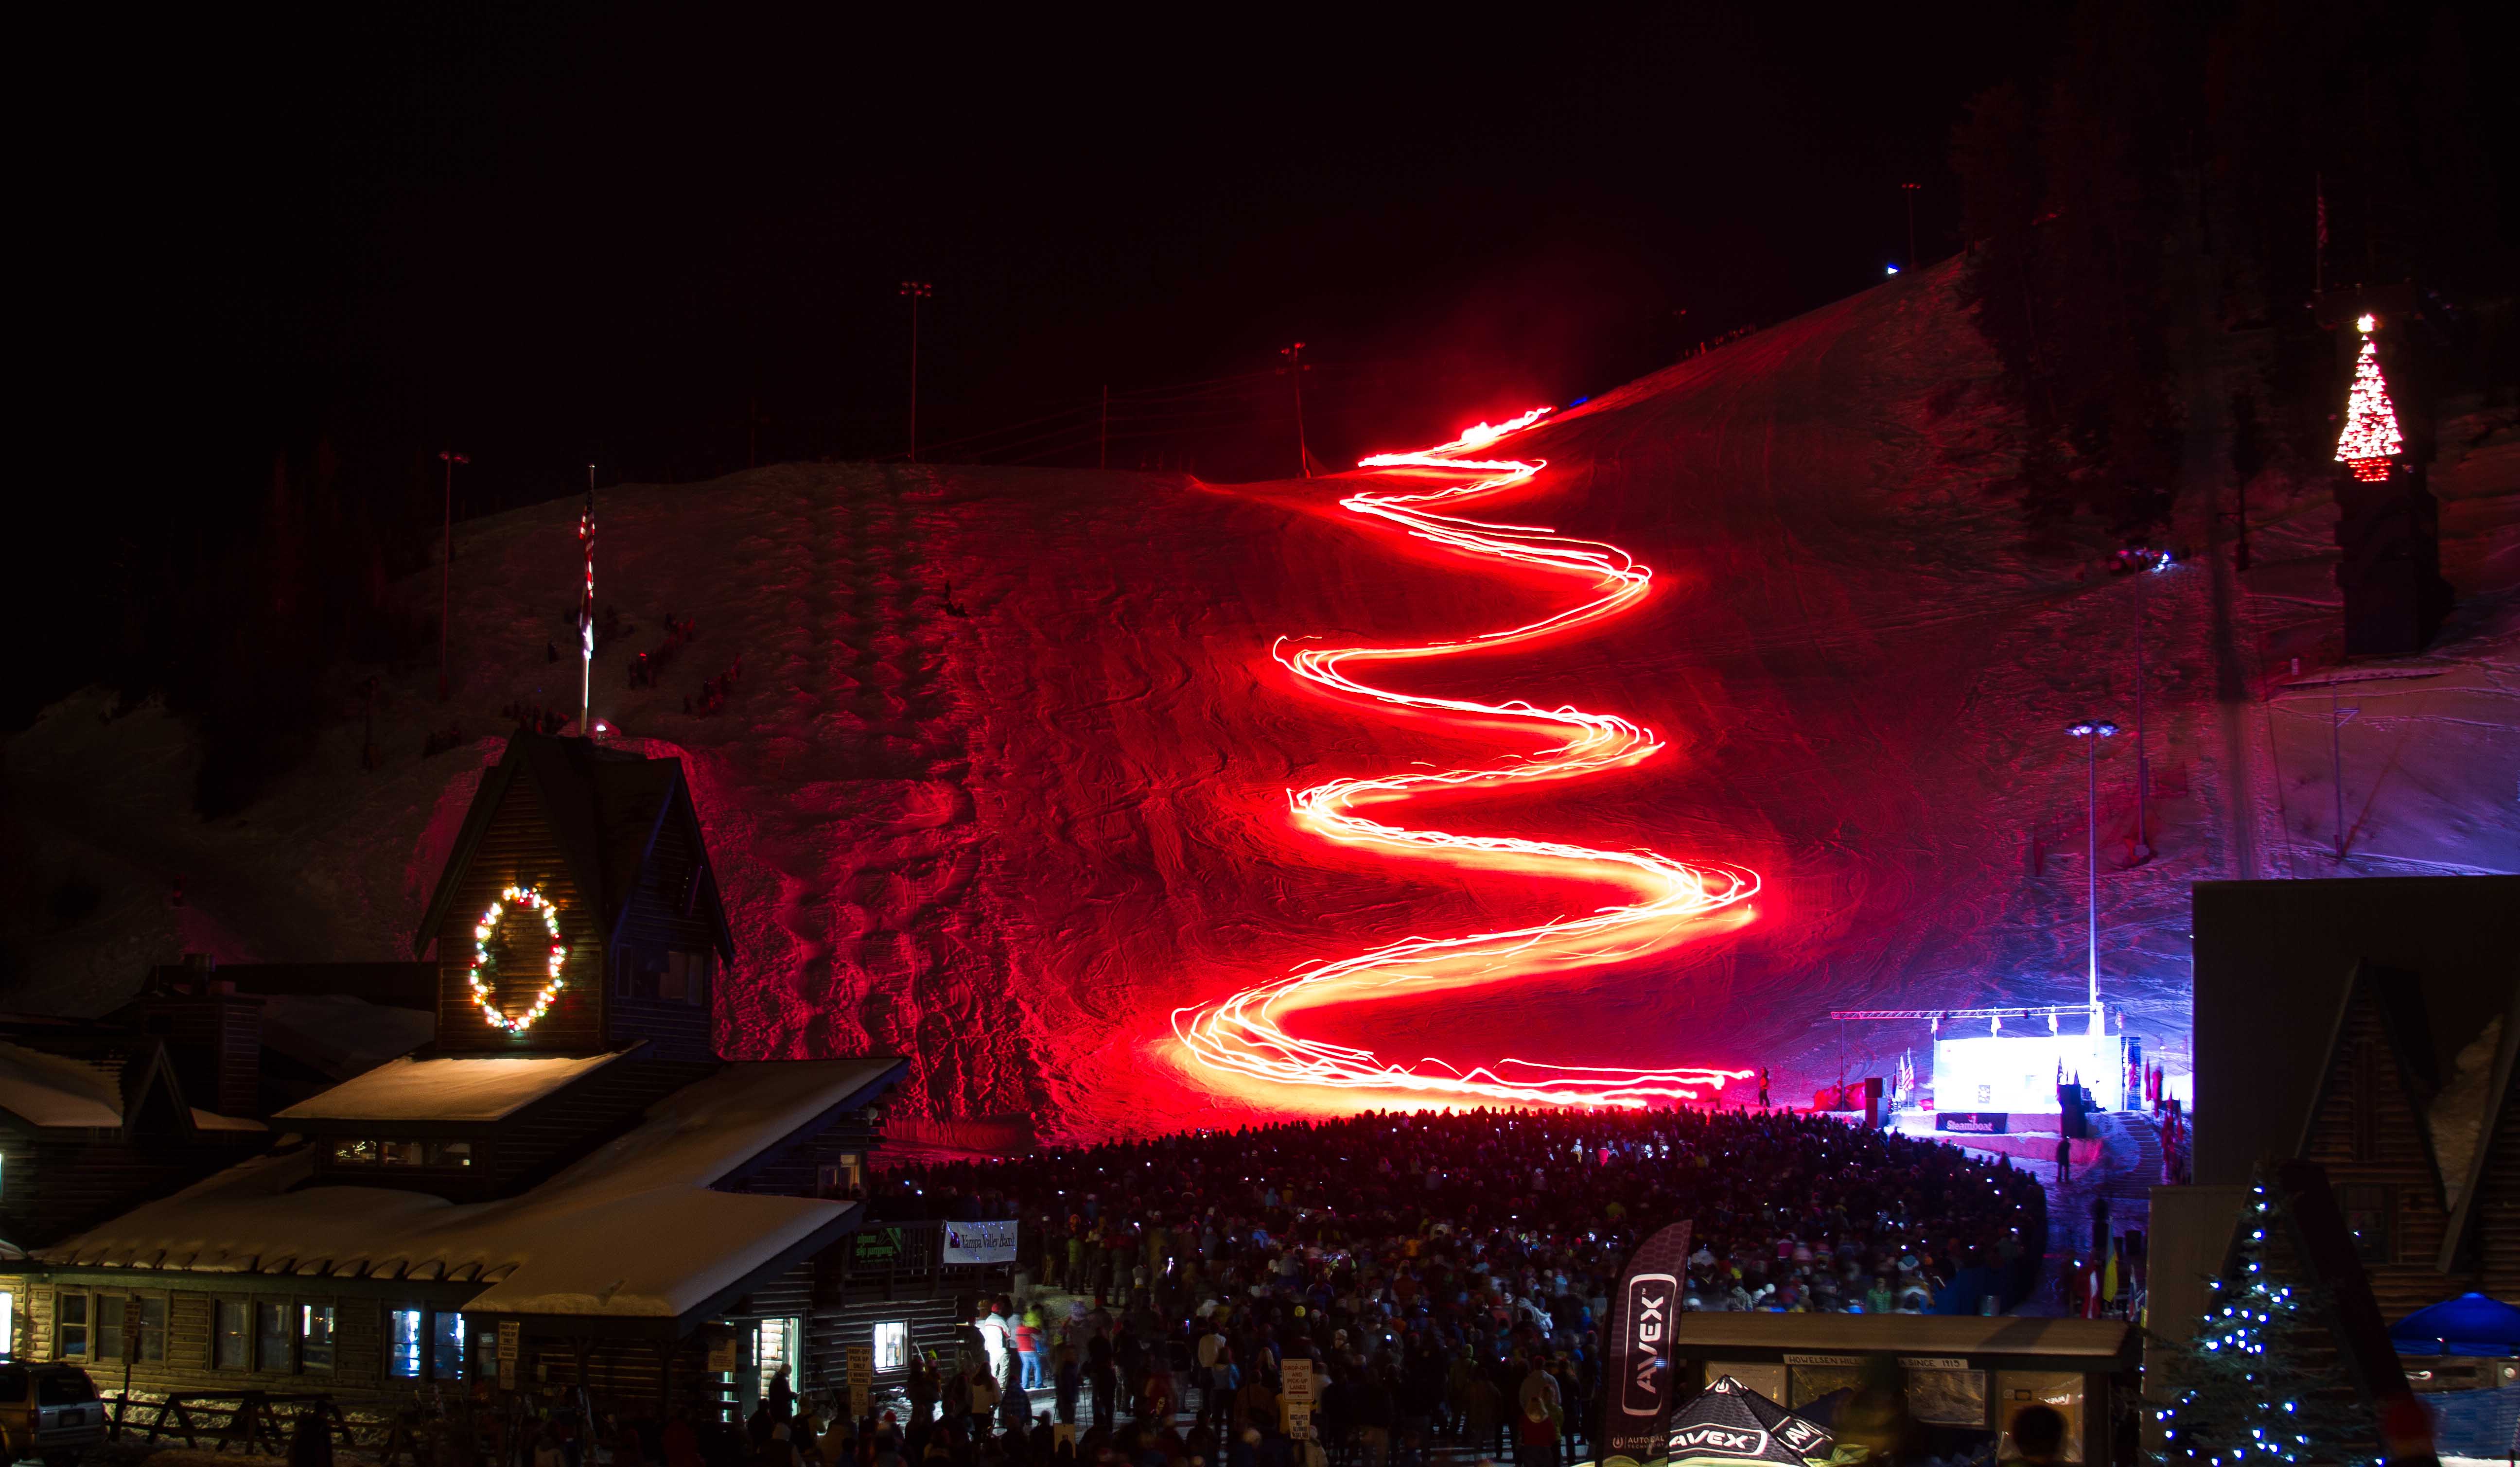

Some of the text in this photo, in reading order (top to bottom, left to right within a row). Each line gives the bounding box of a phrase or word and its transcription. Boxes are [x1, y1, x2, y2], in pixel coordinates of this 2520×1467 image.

[1946, 1116, 1993, 1131] Steamboat
[962, 1234, 982, 1252] Yampa
[981, 1233, 999, 1250] Valley
[1636, 1296, 1664, 1394] AVEX
[1788, 1355, 1838, 1364] HOWELSEN
[1669, 1430, 1749, 1450] AVEX
